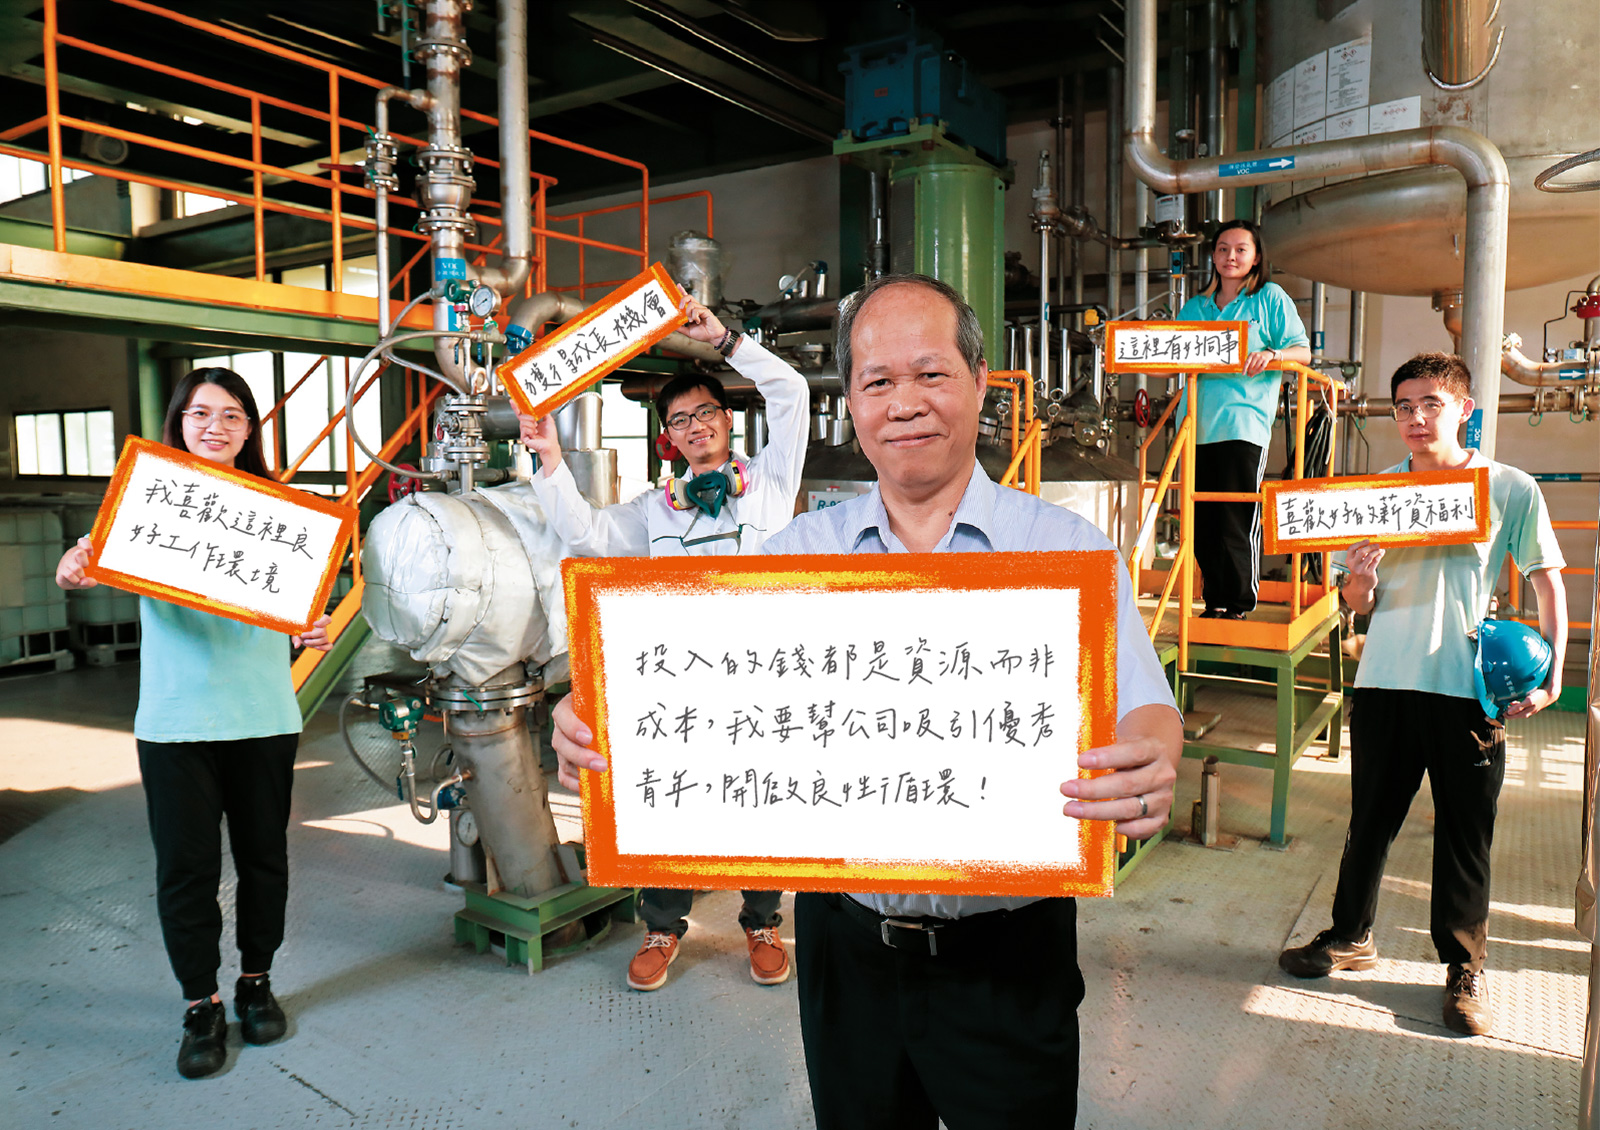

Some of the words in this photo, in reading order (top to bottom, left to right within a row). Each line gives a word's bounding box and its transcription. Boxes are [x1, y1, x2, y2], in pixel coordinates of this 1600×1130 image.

[525, 290, 666, 396] 獲得成長機會
[1118, 328, 1239, 365] 這裡有好同事
[146, 479, 313, 560] 我喜歡這裡良
[1280, 493, 1474, 535] 喜歡好的薪資福利
[130, 523, 280, 594] 好工作環境
[636, 638, 1055, 685] 投入的錢都是資源而非
